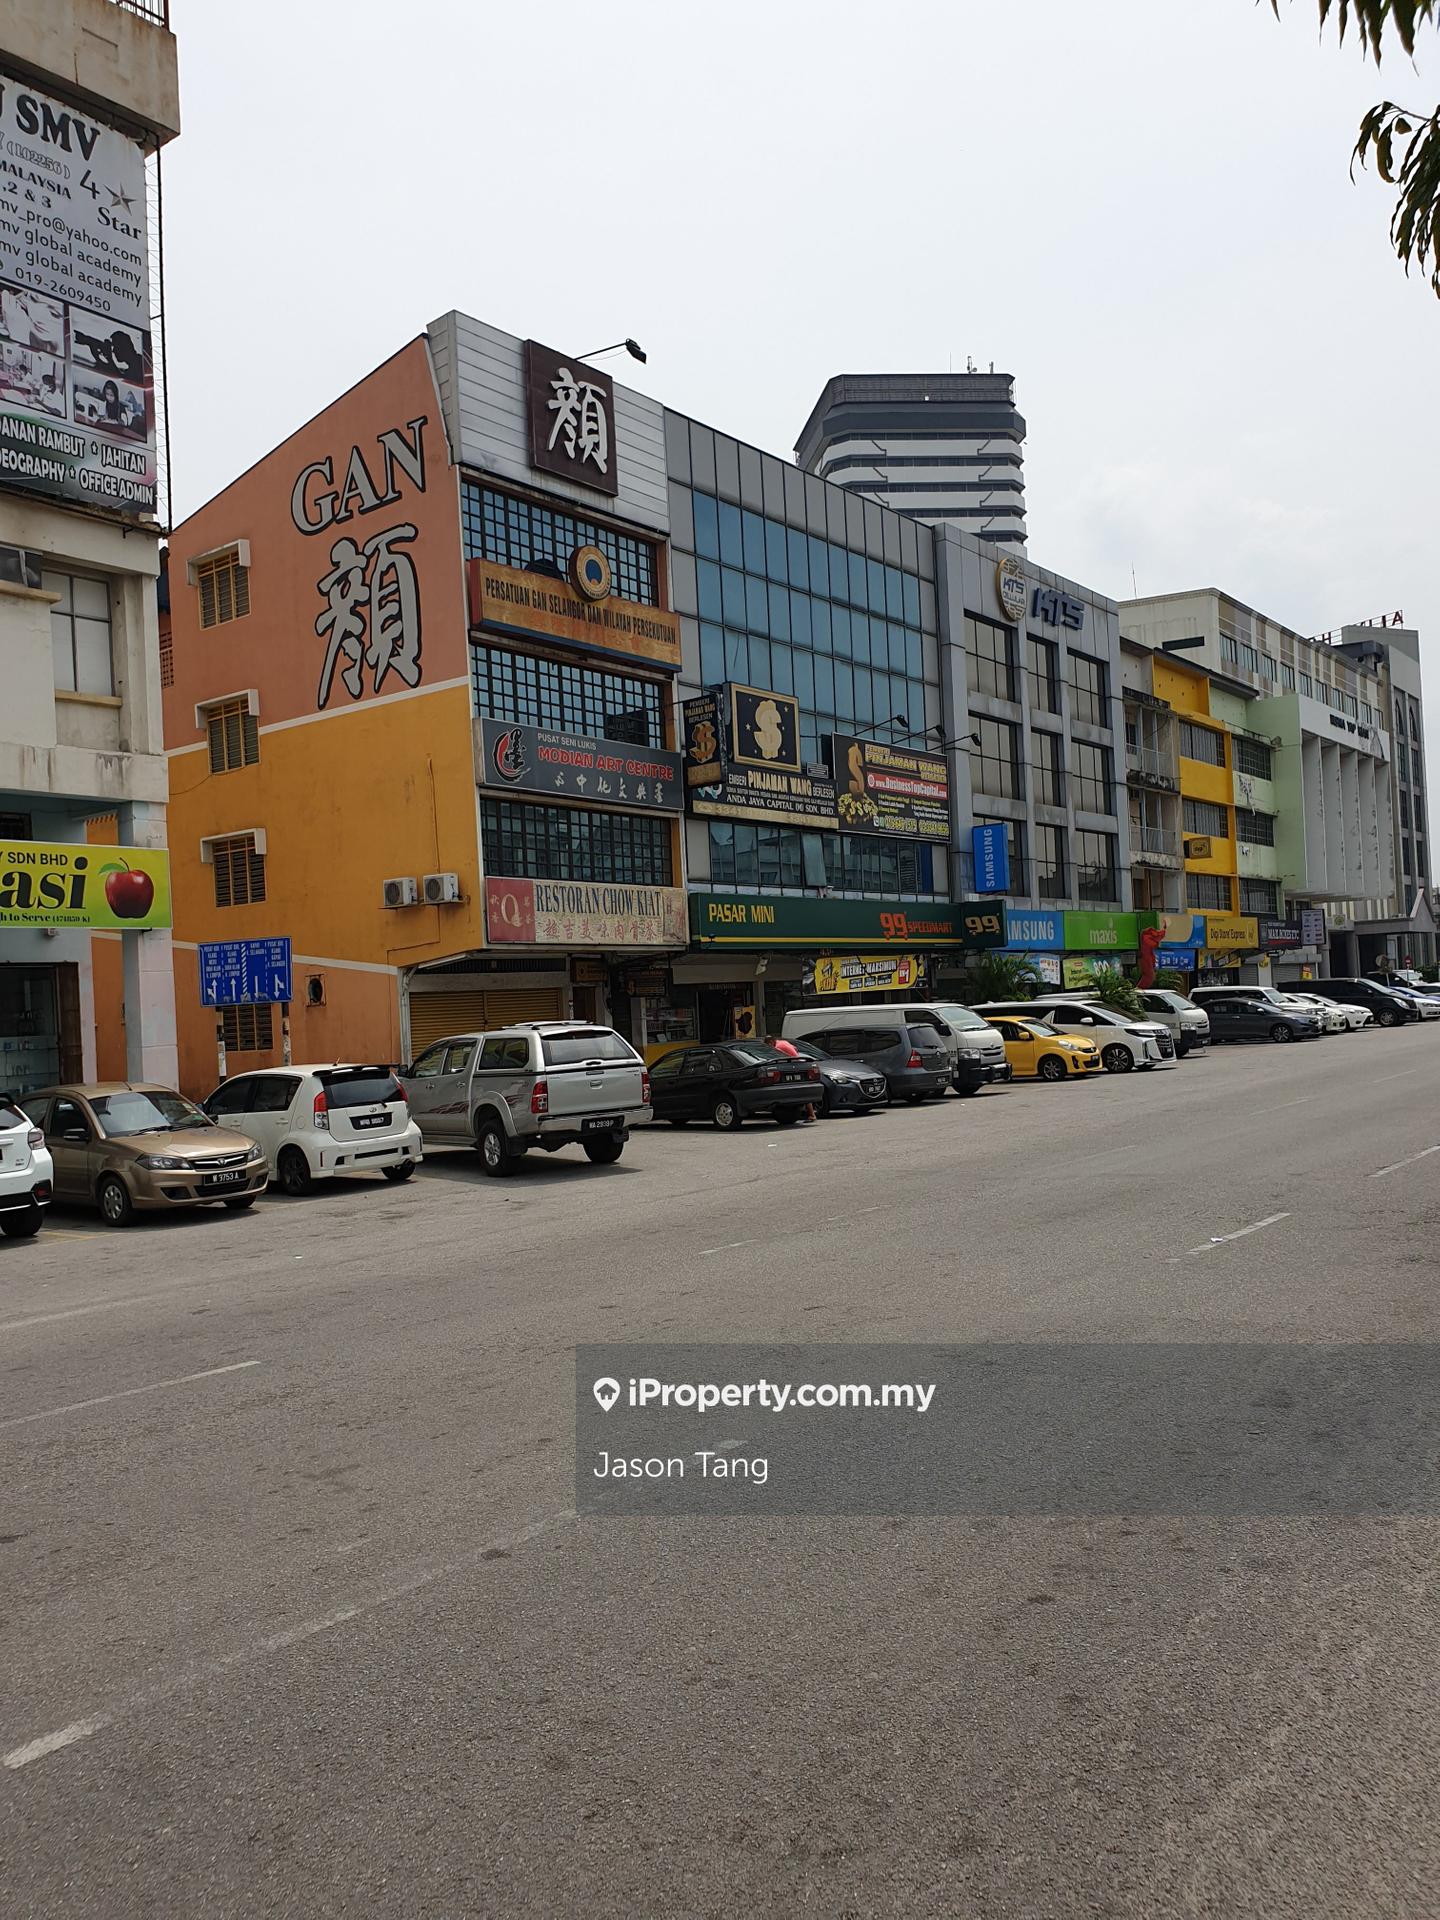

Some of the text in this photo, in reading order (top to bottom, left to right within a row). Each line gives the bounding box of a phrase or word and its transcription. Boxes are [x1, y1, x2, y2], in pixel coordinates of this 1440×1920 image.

[16, 94, 101, 161] SMV
[25, 189, 35, 202] &
[42, 196, 51, 208] 3
[80, 168, 100, 200] 4
[97, 206, 141, 240] Star
[25, 228, 73, 256] global
[77, 251, 141, 288] academy
[15, 267, 111, 312] 019-2609450
[25, 249, 74, 277] global
[78, 271, 142, 307] academy
[0, 414, 146, 474] ANAN RAMBUT JAHITAN
[0, 447, 153, 504] EOGRAPHY OFFICE ADMIN
[291, 416, 428, 536] GAN
[1003, 577, 1024, 595] KTS
[485, 577, 676, 645] PERSATUAN GAN SELANGOR DAN WILAYAH PERSEKUTUAN
[1032, 587, 1085, 631] KTS
[537, 733, 597, 750] PUSAT SENI LUKIS
[538, 745, 594, 768] MODIAN
[597, 755, 624, 772] ART
[626, 760, 674, 780] CENTRE
[865, 753, 947, 775] PINJAMAN WANG
[747, 771, 788, 793] PINJAMAN
[791, 777, 812, 796] WANG
[726, 795, 747, 804] ANDA
[748, 797, 768, 806] JAYA
[767, 798, 794, 811] CAPITAL
[805, 804, 819, 815] SDN.
[8, 852, 68, 866] SDN BHD
[984, 829, 995, 887] SAMSUNG
[536, 884, 600, 915] RESTORAN
[602, 887, 635, 916] CHOW
[637, 890, 661, 917] KIAT
[708, 903, 746, 923] PASAR
[751, 904, 775, 923] MINI
[9, 912, 20, 922] to
[22, 912, 50, 922] Serve
[879, 912, 953, 939] 99 SPEEDMART
[965, 914, 1000, 936] 99
[1090, 929, 1118, 944] maxis
